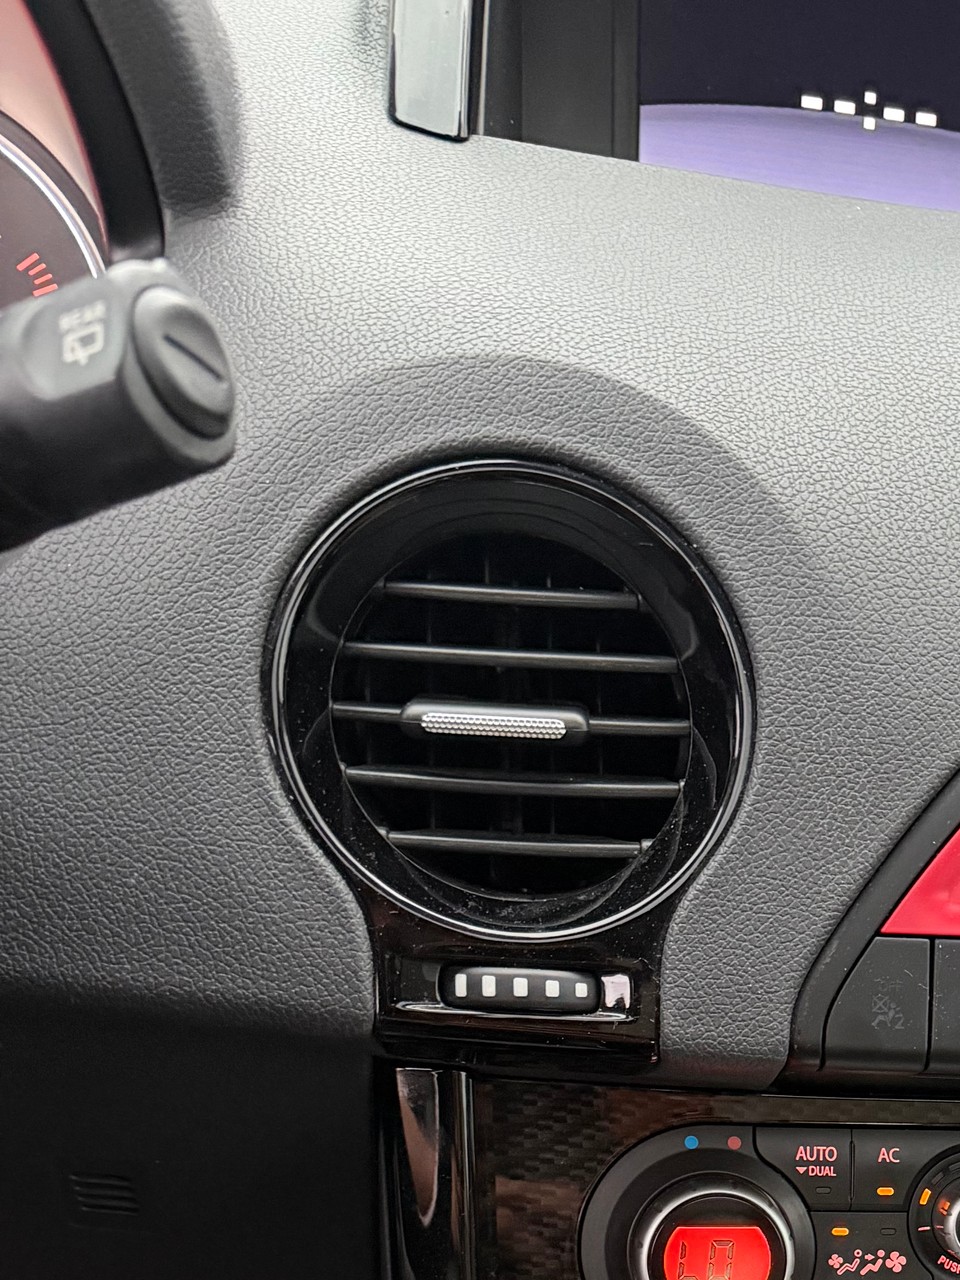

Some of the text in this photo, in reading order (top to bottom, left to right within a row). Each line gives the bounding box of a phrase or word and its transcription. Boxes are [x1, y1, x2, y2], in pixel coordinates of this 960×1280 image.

[795, 1146, 838, 1162] AUTO
[877, 1147, 900, 1163] AC
[808, 1165, 837, 1177] DUAL
